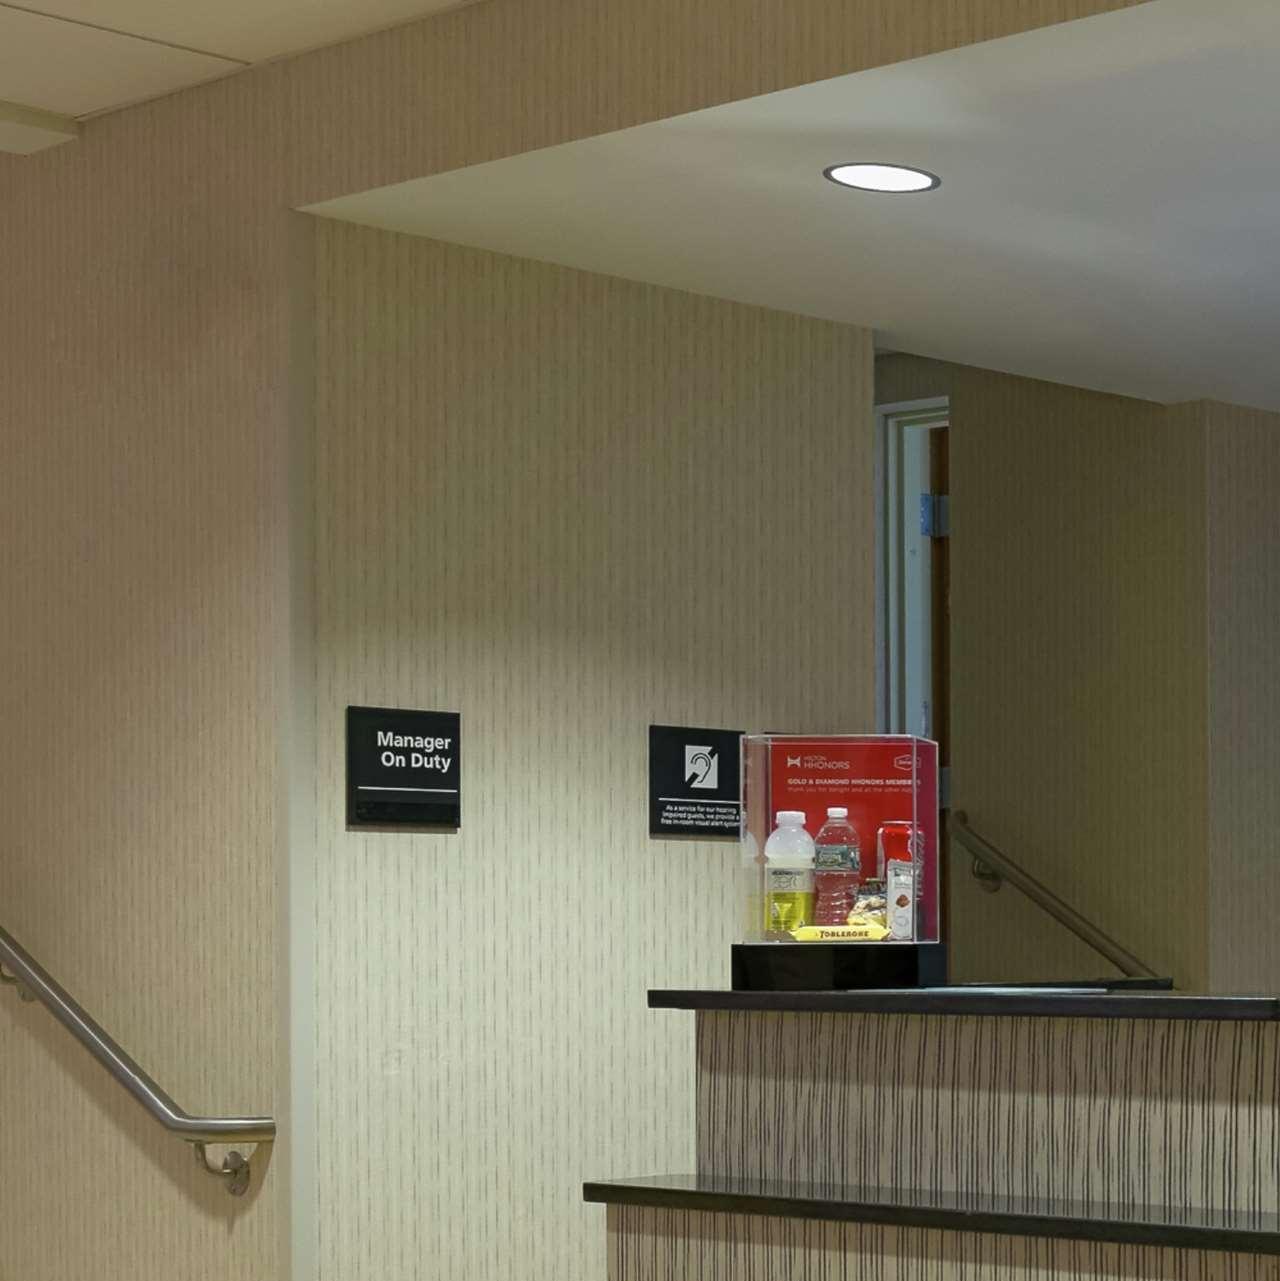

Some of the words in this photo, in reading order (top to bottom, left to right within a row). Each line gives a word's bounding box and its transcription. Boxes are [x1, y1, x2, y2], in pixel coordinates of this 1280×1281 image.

[377, 730, 452, 753] Manager
[380, 751, 406, 767] On
[411, 752, 452, 774] Duty
[803, 760, 851, 769] HHONORS
[819, 930, 870, 939] TOBLERONE
